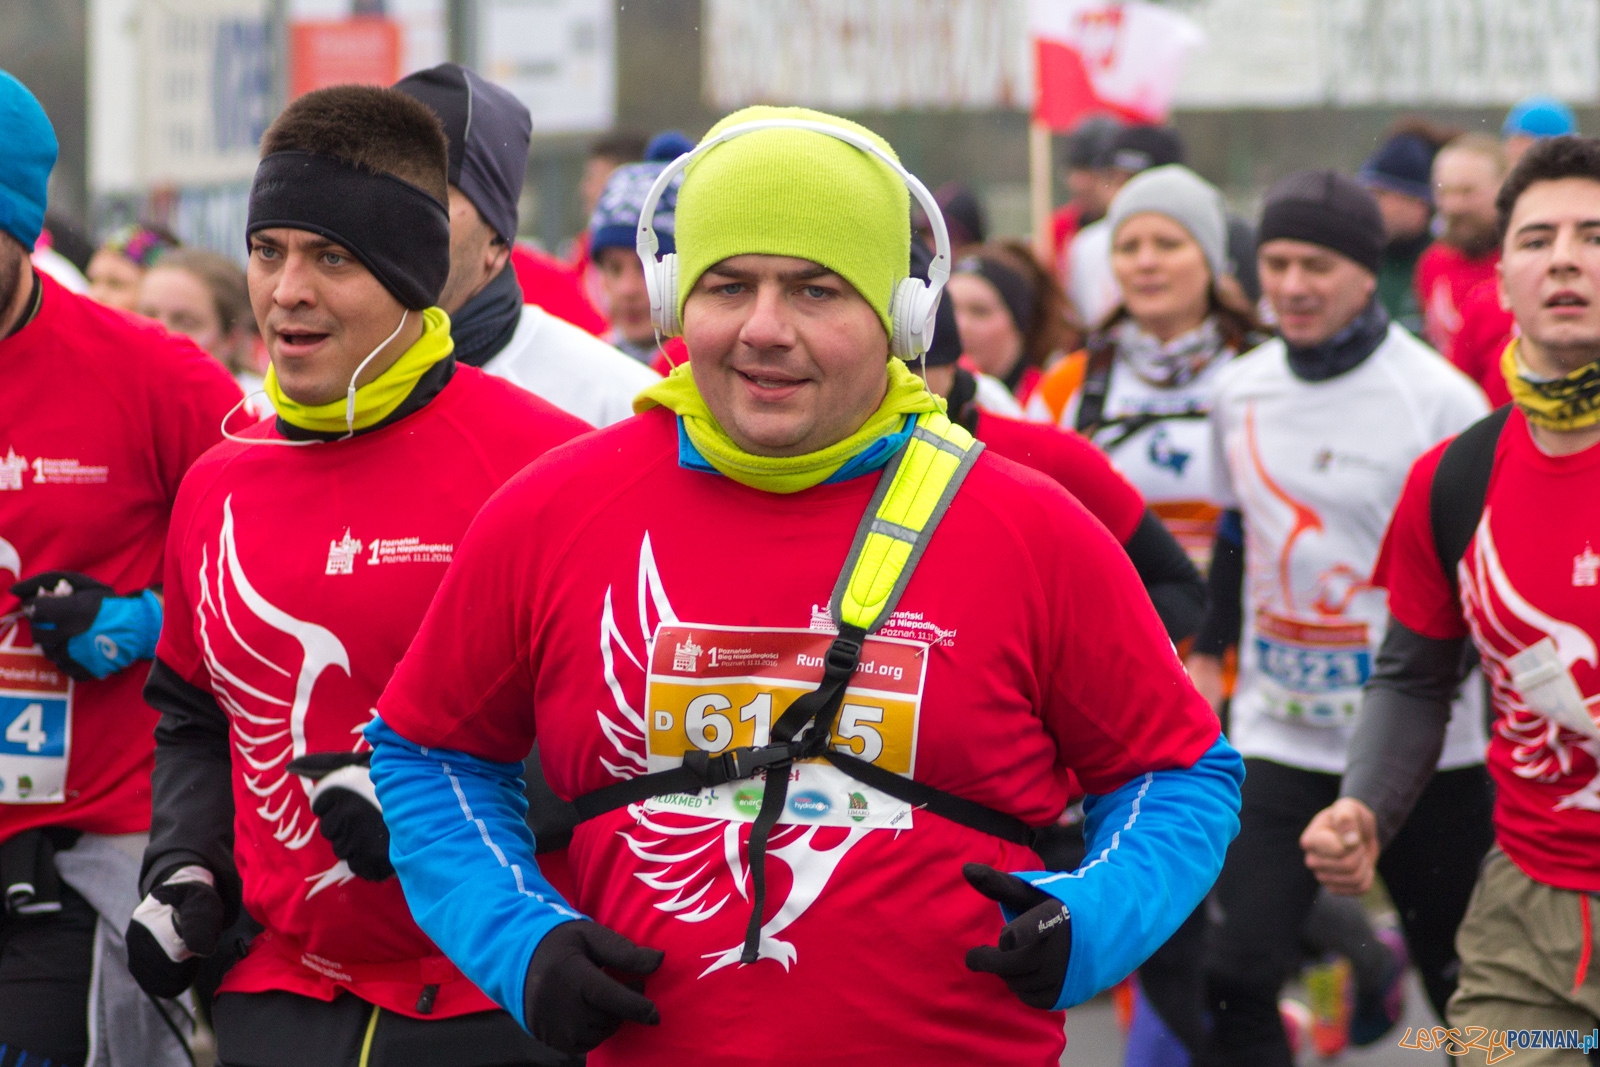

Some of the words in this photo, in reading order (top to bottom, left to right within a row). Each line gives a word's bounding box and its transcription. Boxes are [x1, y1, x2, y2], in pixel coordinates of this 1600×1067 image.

[367, 538, 380, 565] 1
[707, 647, 719, 667] 1
[654, 710, 674, 731] D
[684, 692, 884, 765] 615
